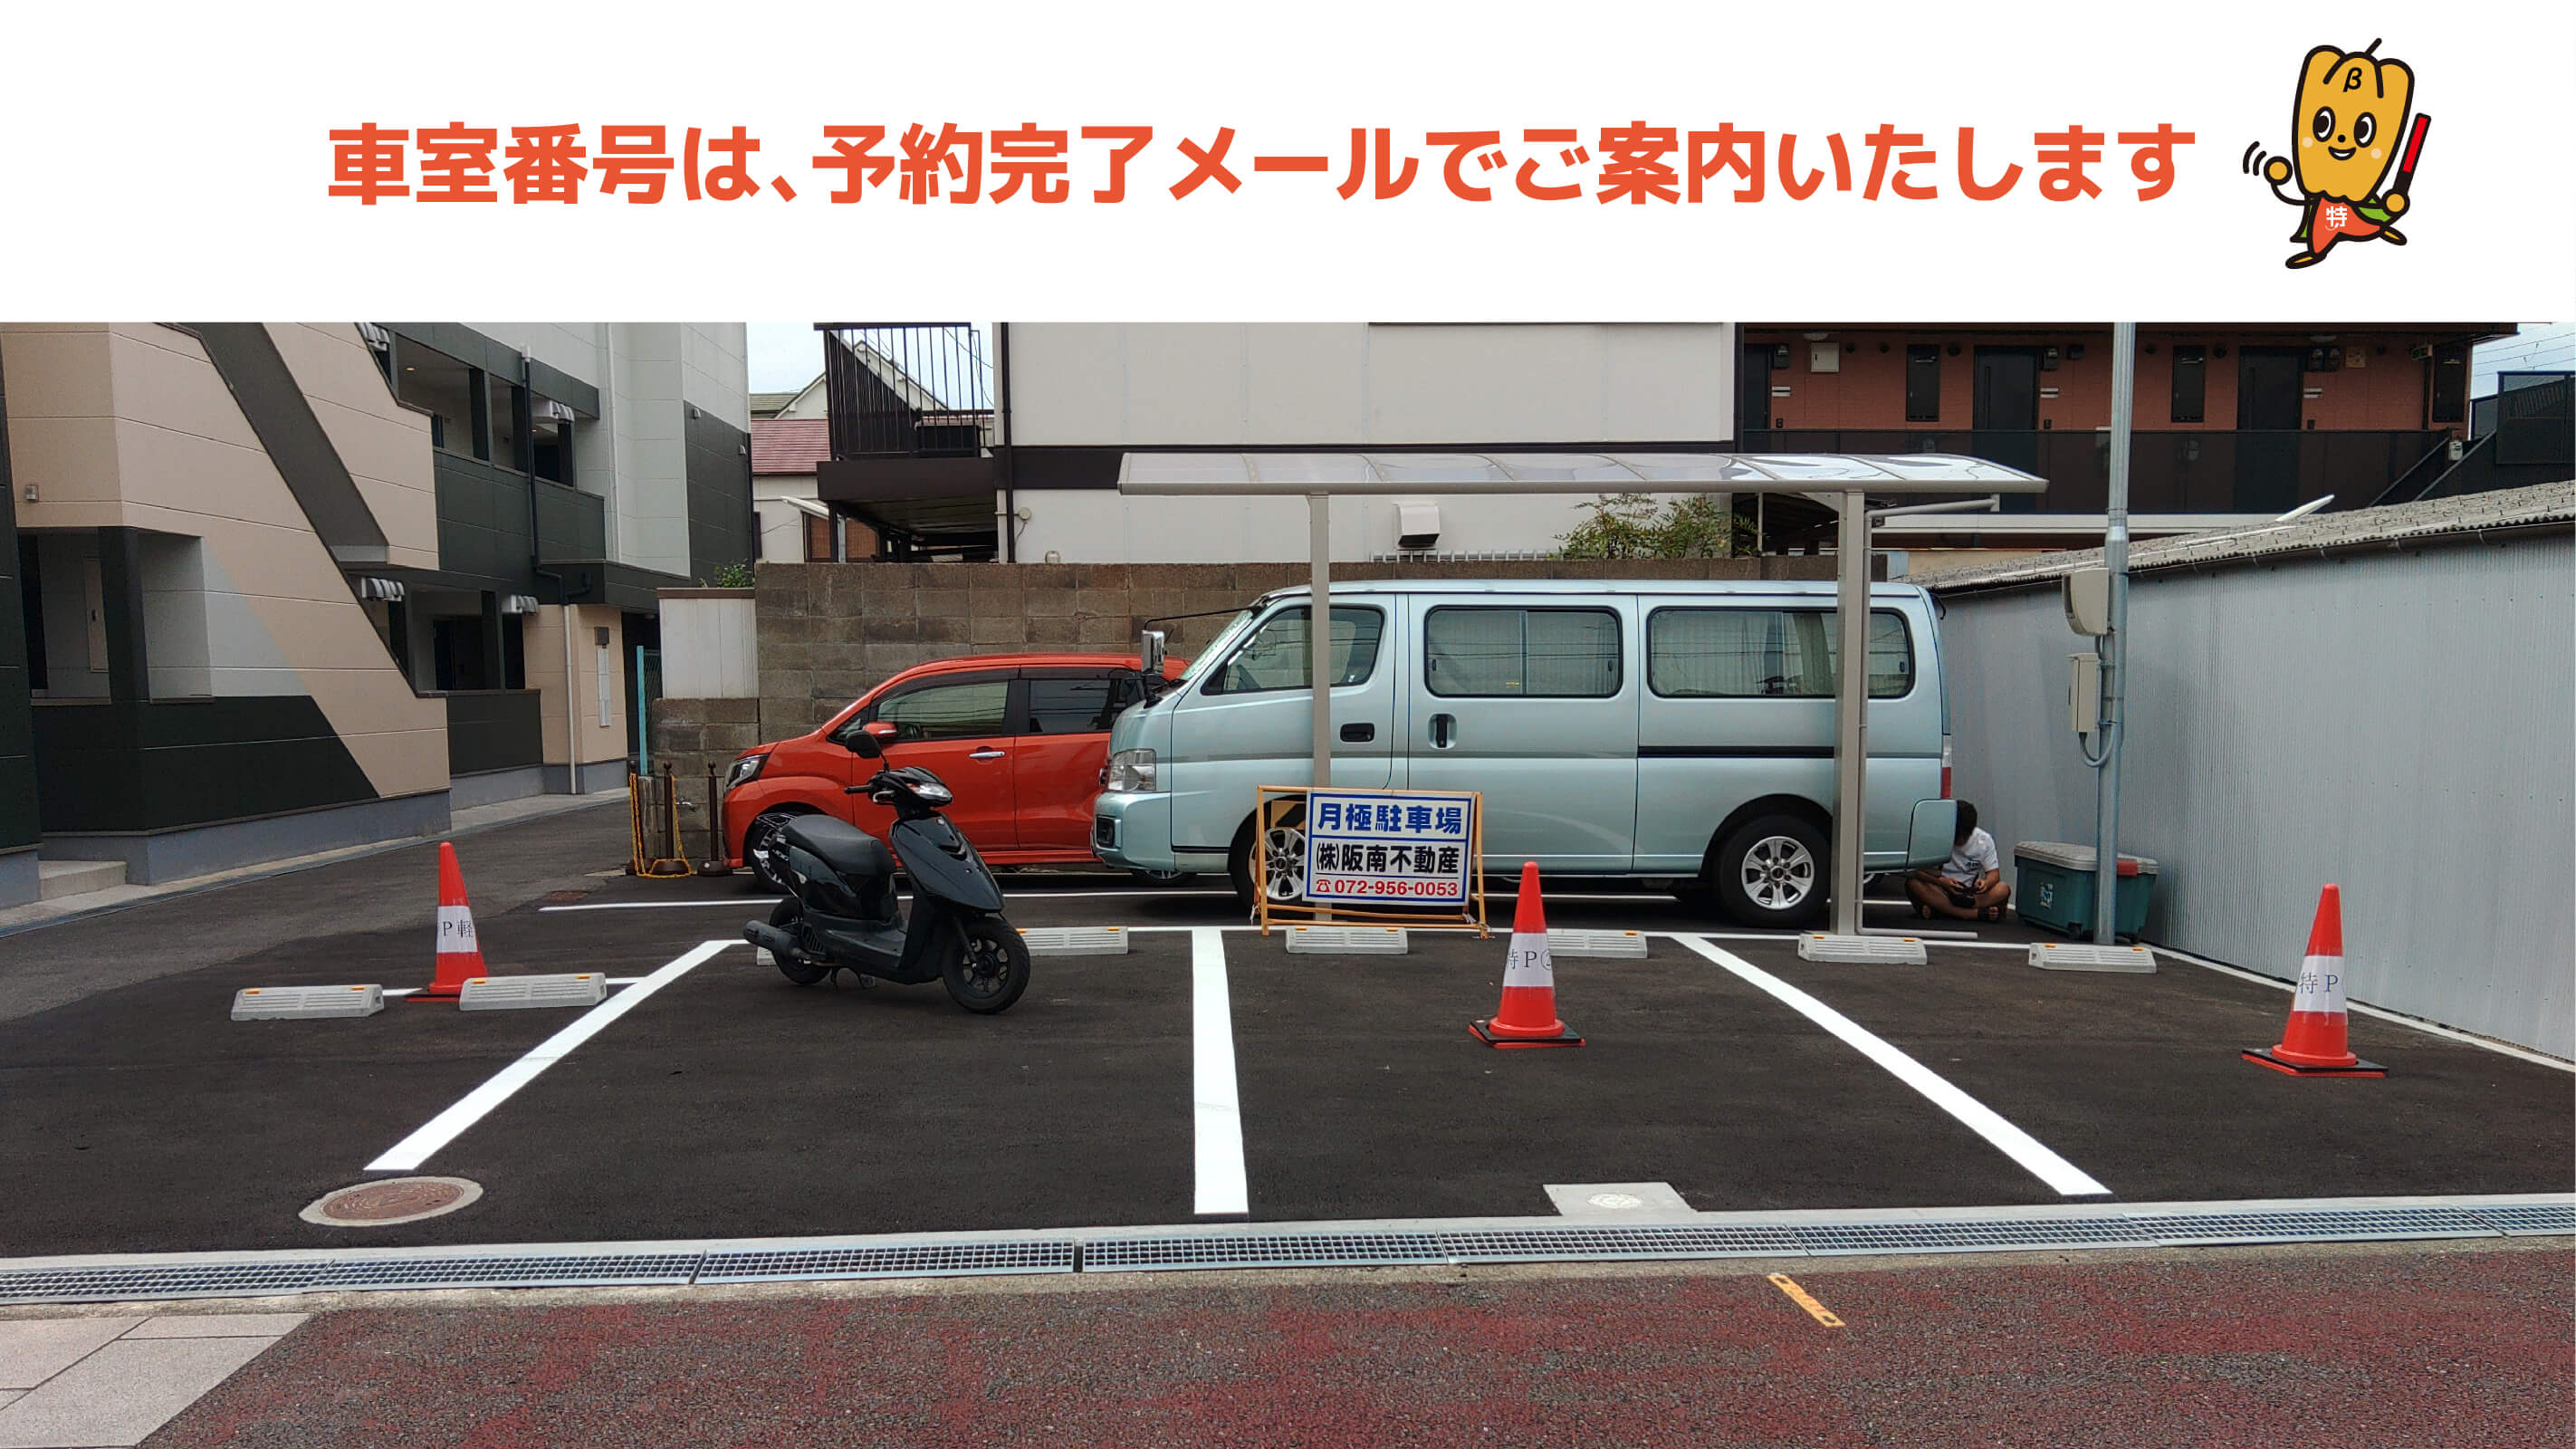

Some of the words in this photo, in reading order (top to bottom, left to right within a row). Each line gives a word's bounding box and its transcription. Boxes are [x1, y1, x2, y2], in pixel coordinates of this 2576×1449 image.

[1317, 802, 1462, 835] 月極駐車場
[1335, 879, 1458, 897] 072-956-0053
